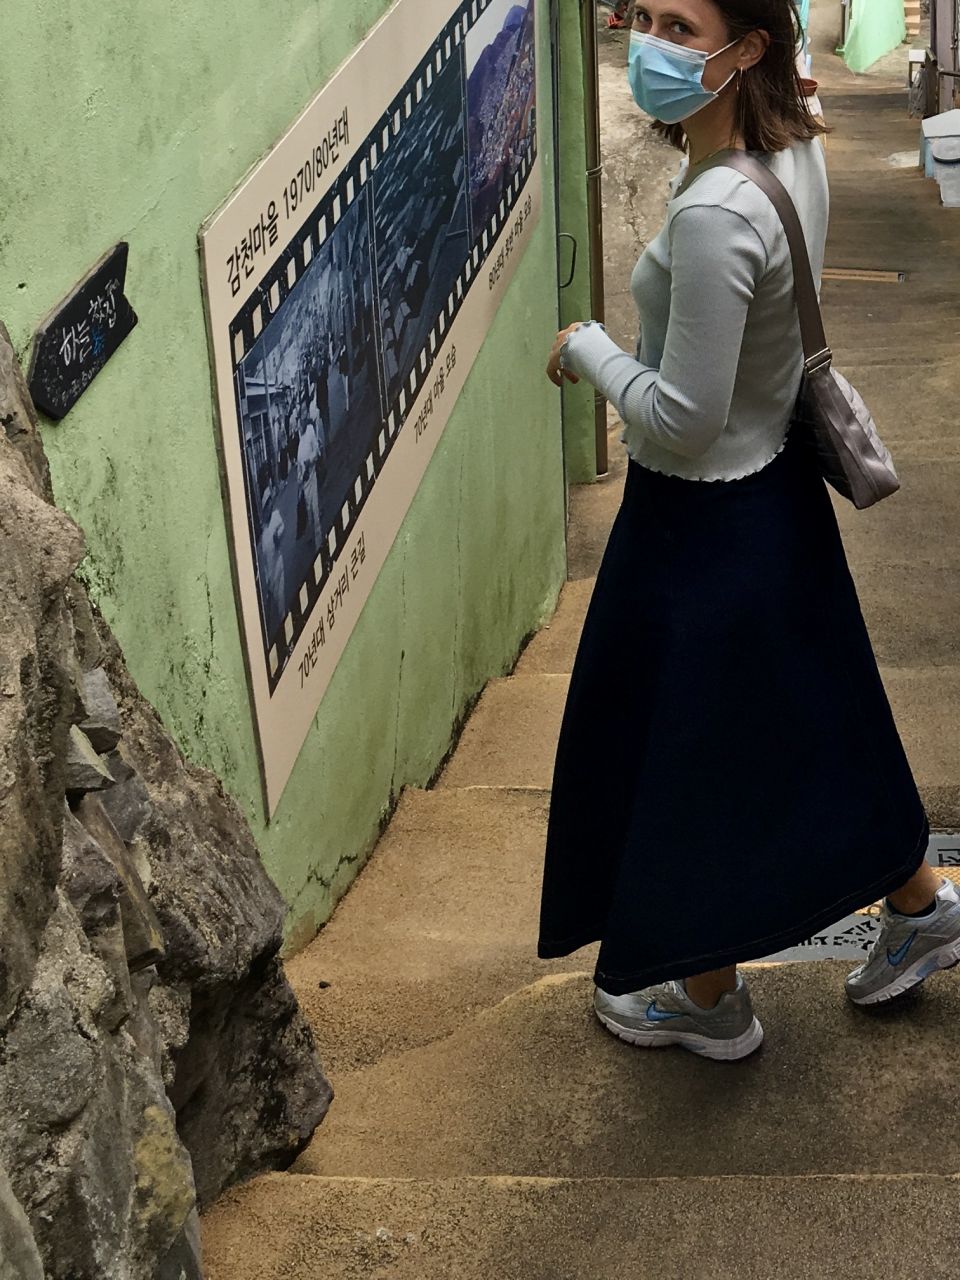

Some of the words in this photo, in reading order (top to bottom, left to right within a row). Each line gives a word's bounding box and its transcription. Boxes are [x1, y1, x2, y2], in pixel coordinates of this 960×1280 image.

[226, 200, 279, 298] 감천마을
[283, 106, 350, 220] 1970/80년대
[59, 319, 93, 366] 하늘
[414, 389, 434, 444] 70년대
[433, 366, 445, 399] 마을
[446, 343, 457, 378] 모습
[298, 616, 326, 688] 70년대
[327, 564, 350, 631] 삼거리
[350, 531, 366, 581] 큰길
